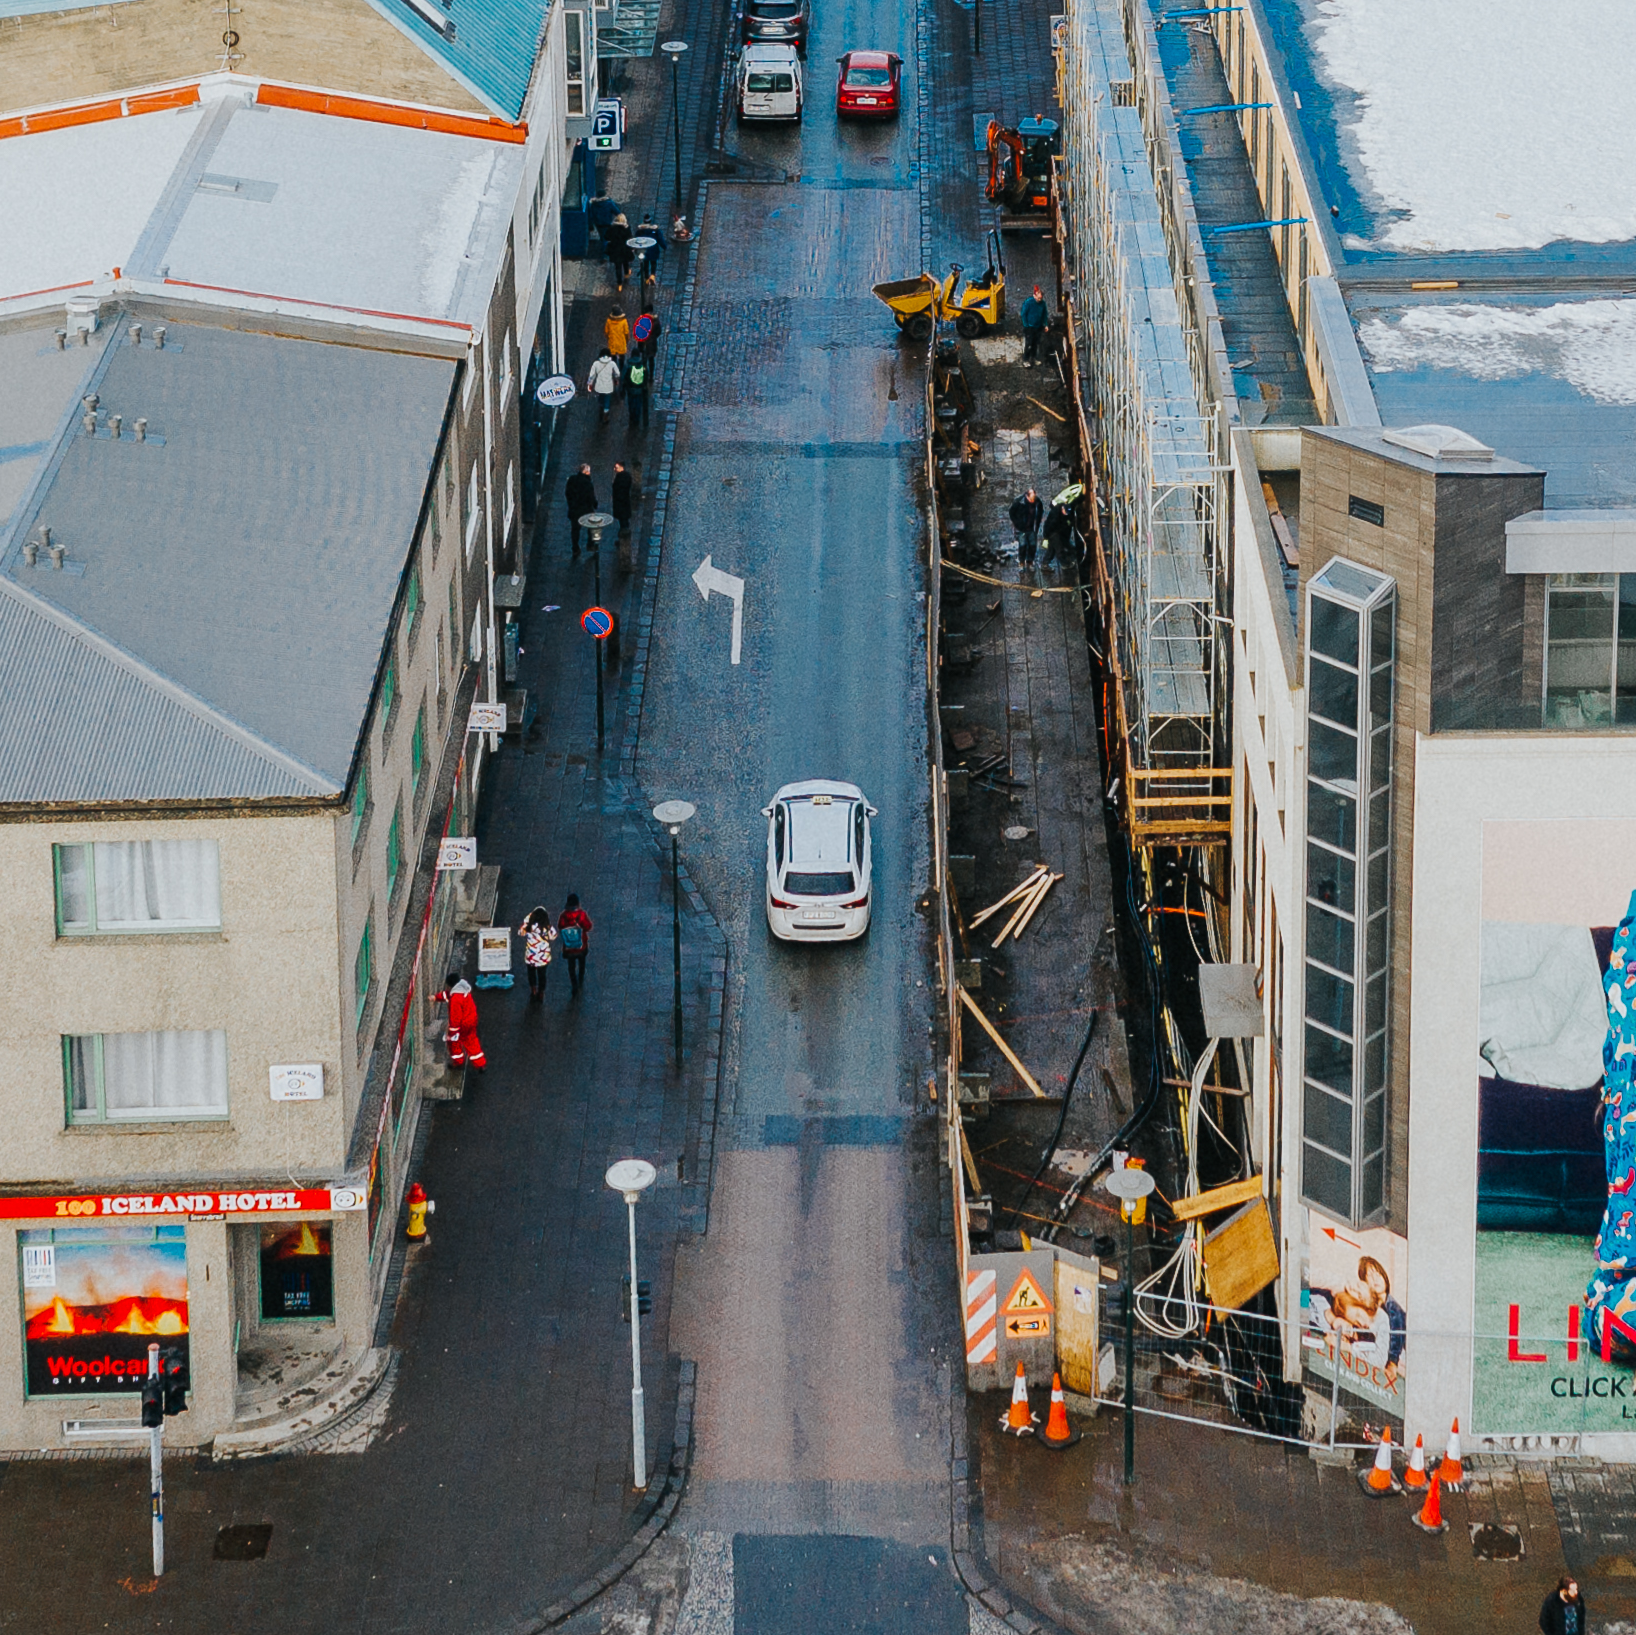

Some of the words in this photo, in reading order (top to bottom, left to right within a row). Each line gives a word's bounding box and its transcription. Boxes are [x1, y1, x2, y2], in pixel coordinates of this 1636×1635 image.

[597, 118, 610, 134] P
[55, 1200, 96, 1216] 100
[101, 1195, 214, 1214] ICELAND
[219, 1192, 301, 1211] HOTEL
[1550, 1376, 1627, 1398] CLICK
